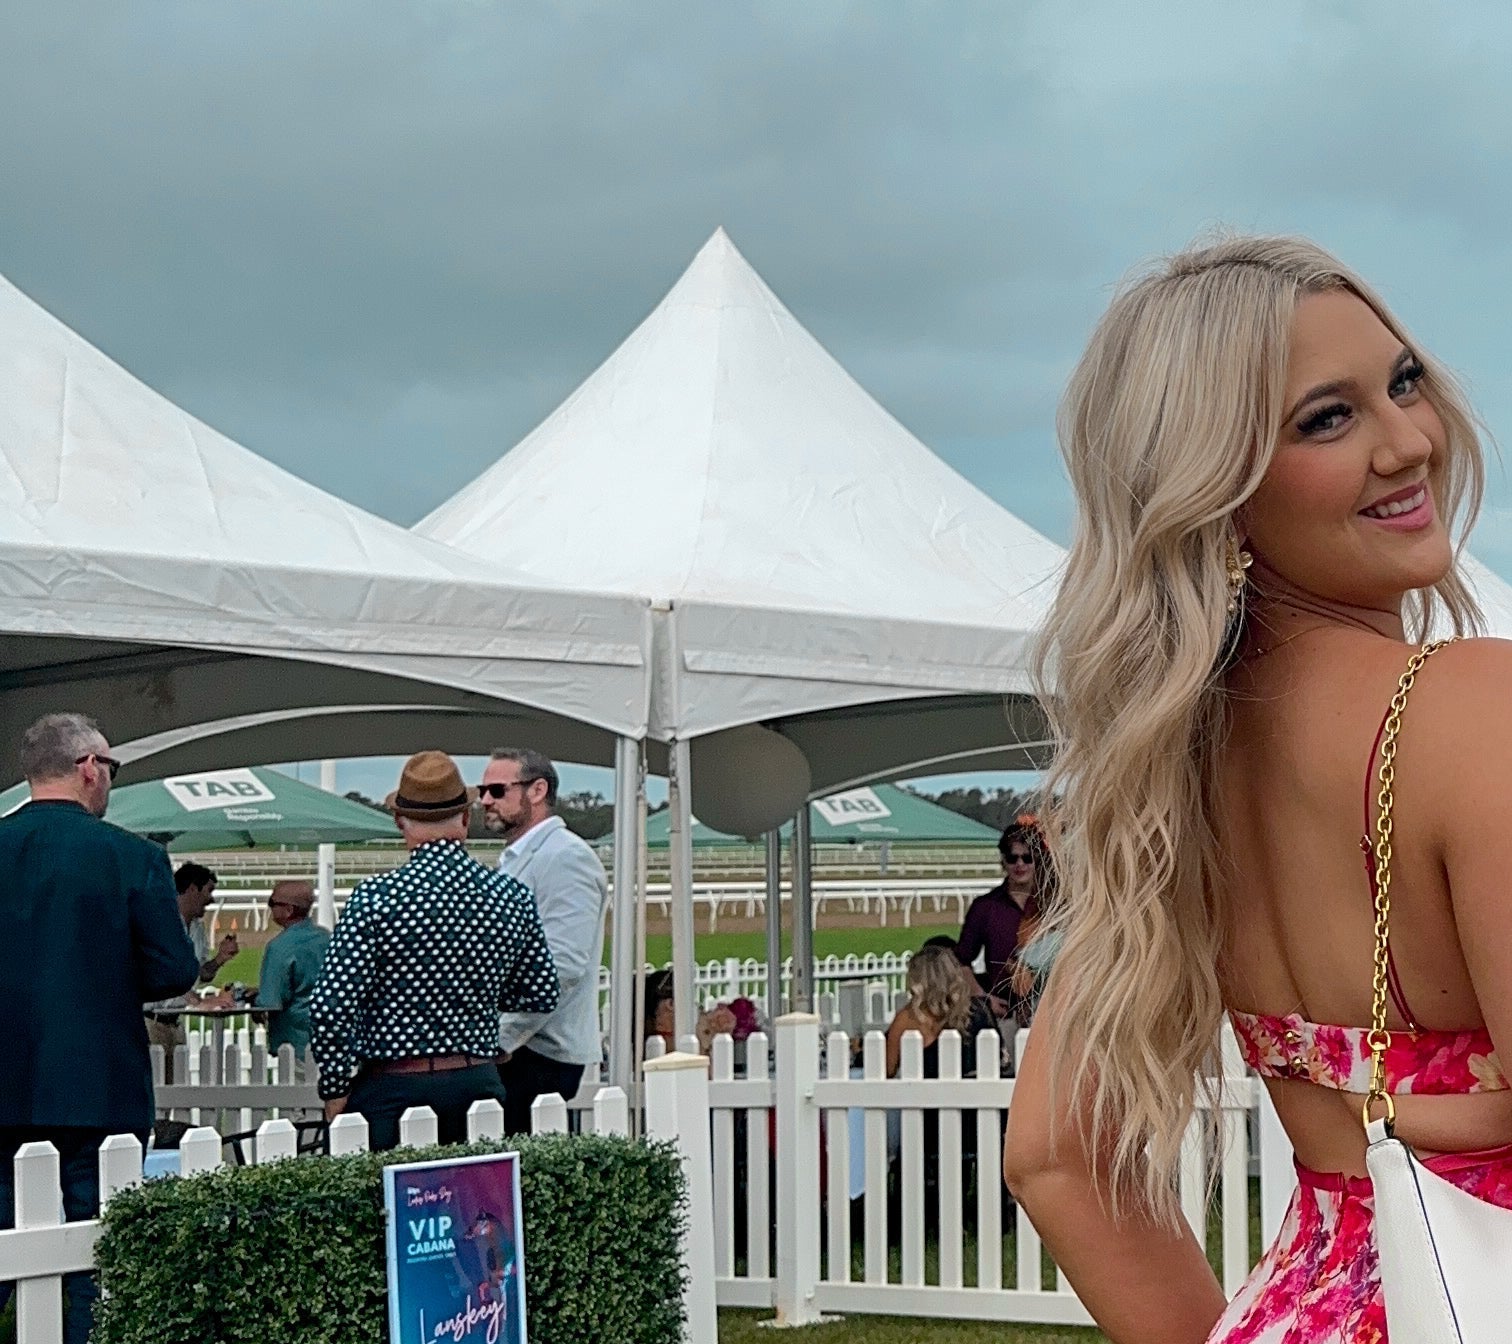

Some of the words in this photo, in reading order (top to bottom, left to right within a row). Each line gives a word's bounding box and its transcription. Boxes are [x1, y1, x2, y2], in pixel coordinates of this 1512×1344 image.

[174, 781, 263, 797] TAB
[825, 798, 882, 813] TAB
[408, 1216, 452, 1241] VIP
[407, 1238, 456, 1256] CABANA
